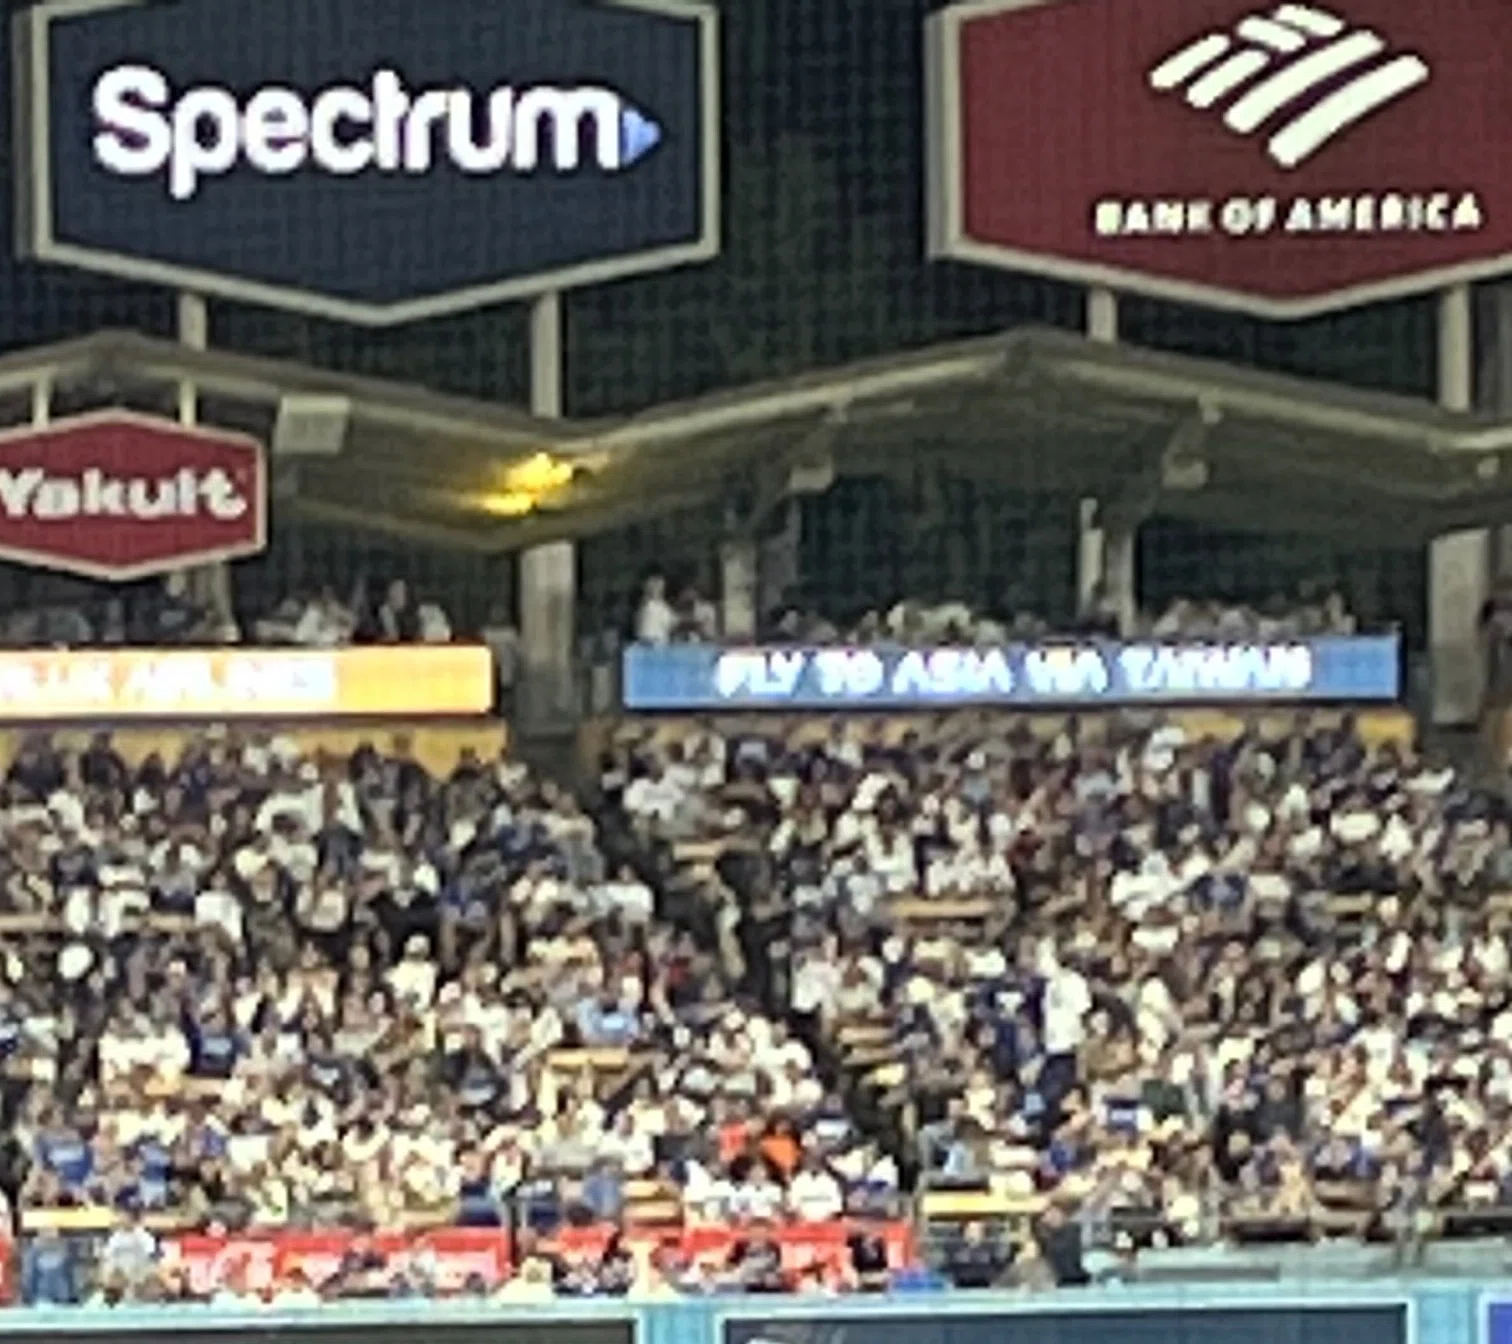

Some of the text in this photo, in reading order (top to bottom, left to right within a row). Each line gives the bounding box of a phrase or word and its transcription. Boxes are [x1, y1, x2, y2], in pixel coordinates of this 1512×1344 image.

[92, 64, 622, 200] Spectrum
[1095, 192, 1481, 235] BANK OF AMERICA
[892, 649, 1013, 694] ASIA
